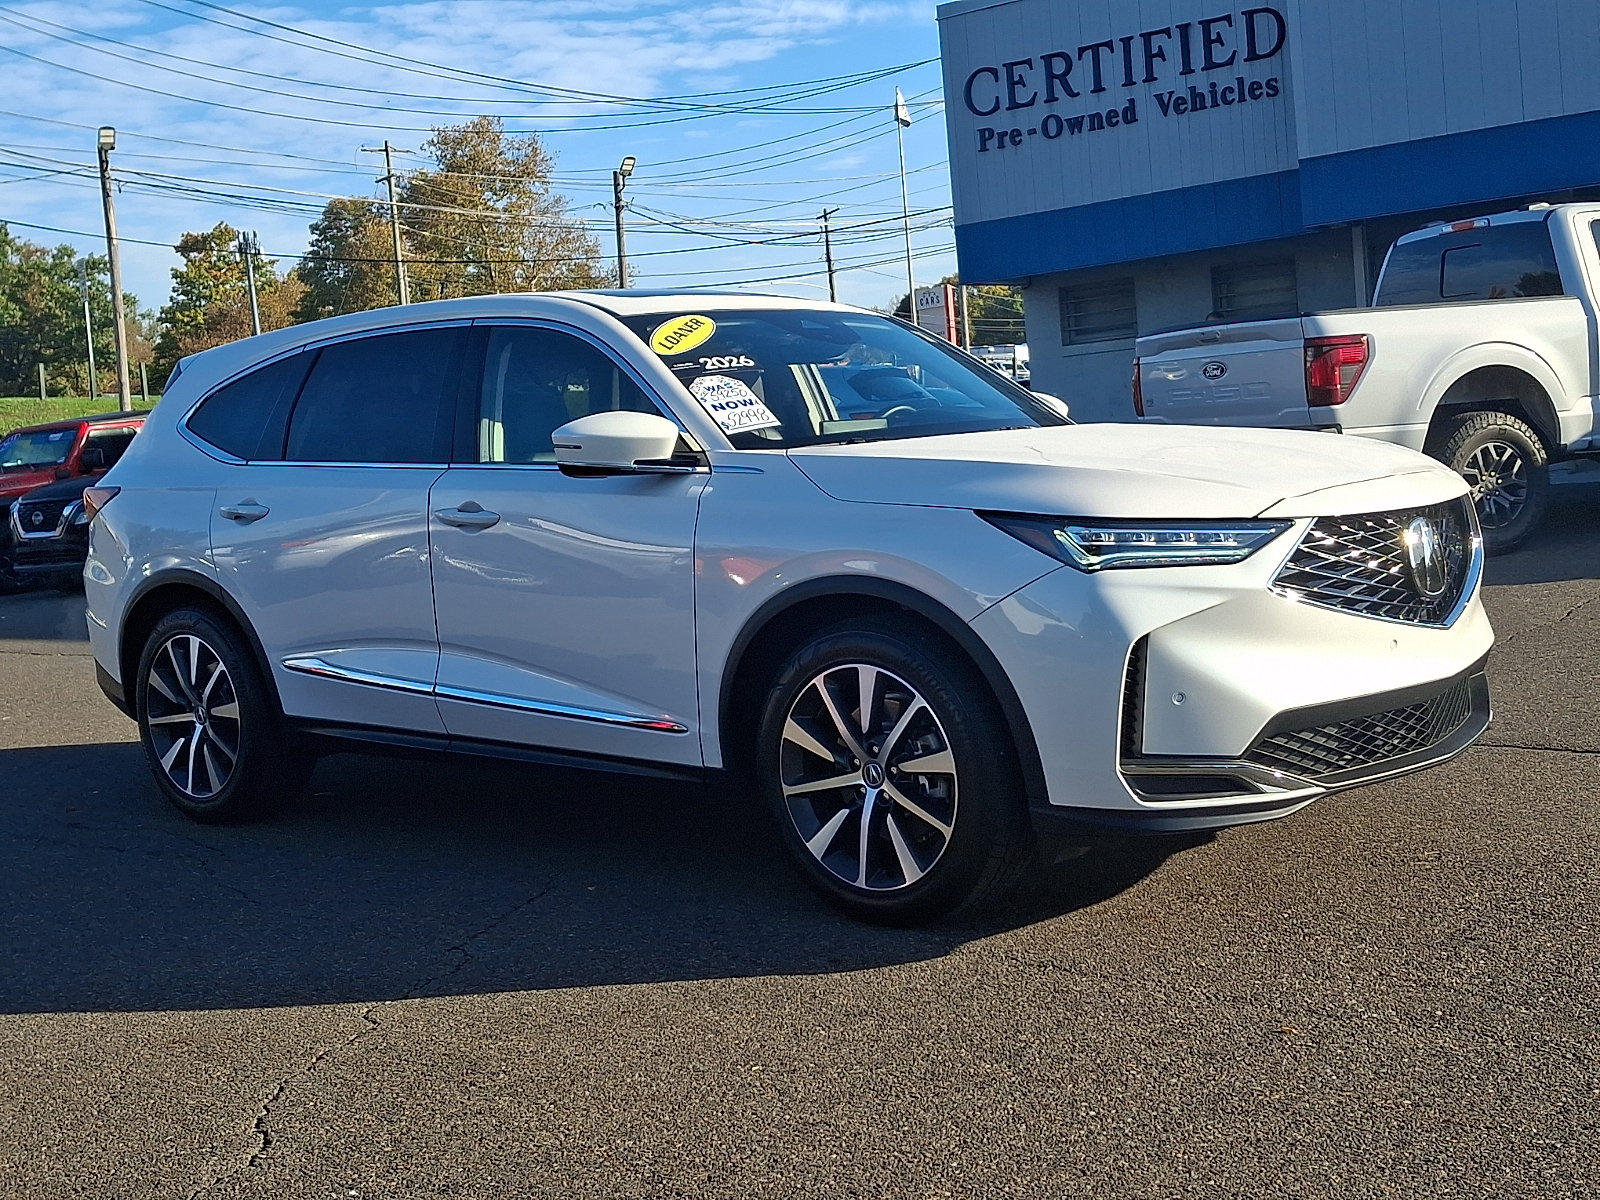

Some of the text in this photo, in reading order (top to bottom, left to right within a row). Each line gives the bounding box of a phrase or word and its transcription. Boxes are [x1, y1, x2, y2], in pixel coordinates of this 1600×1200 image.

[963, 7, 1286, 117] CERTIFIED
[977, 76, 1280, 152] Pre-Owned Vehicles
[919, 295, 940, 307] CARS
[658, 317, 706, 350] LOANER
[698, 355, 755, 370] 2026
[703, 381, 734, 392] WAS
[710, 398, 755, 412] NOW
